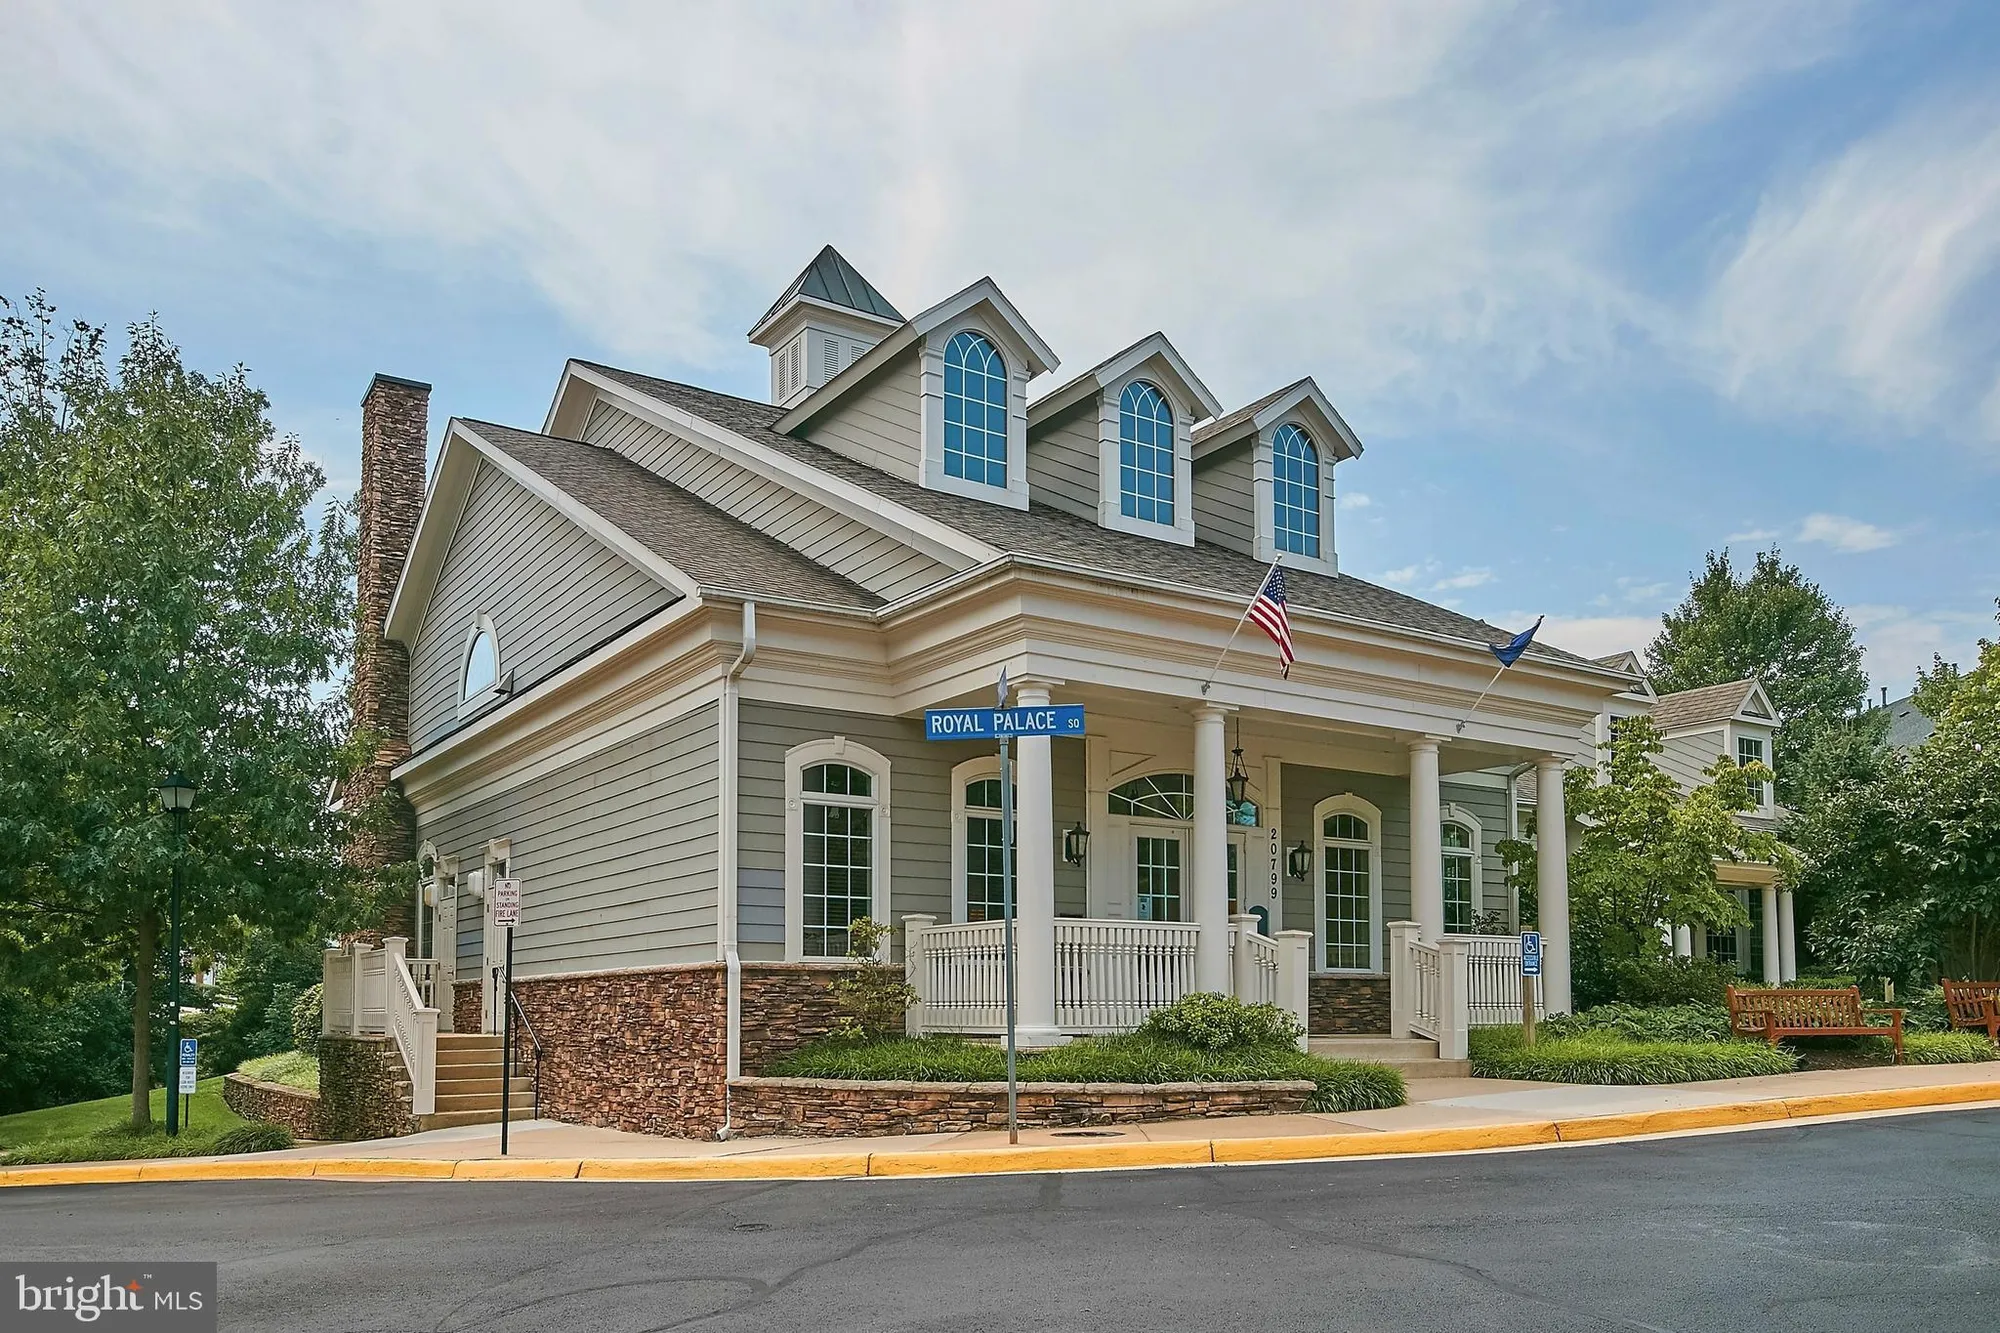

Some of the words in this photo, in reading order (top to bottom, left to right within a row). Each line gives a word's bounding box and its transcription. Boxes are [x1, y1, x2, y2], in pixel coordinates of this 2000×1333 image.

[931, 714, 984, 733] ROYAL
[993, 711, 1057, 731] PALACE
[495, 910, 506, 918] FIRE
[507, 910, 519, 918] LANE
